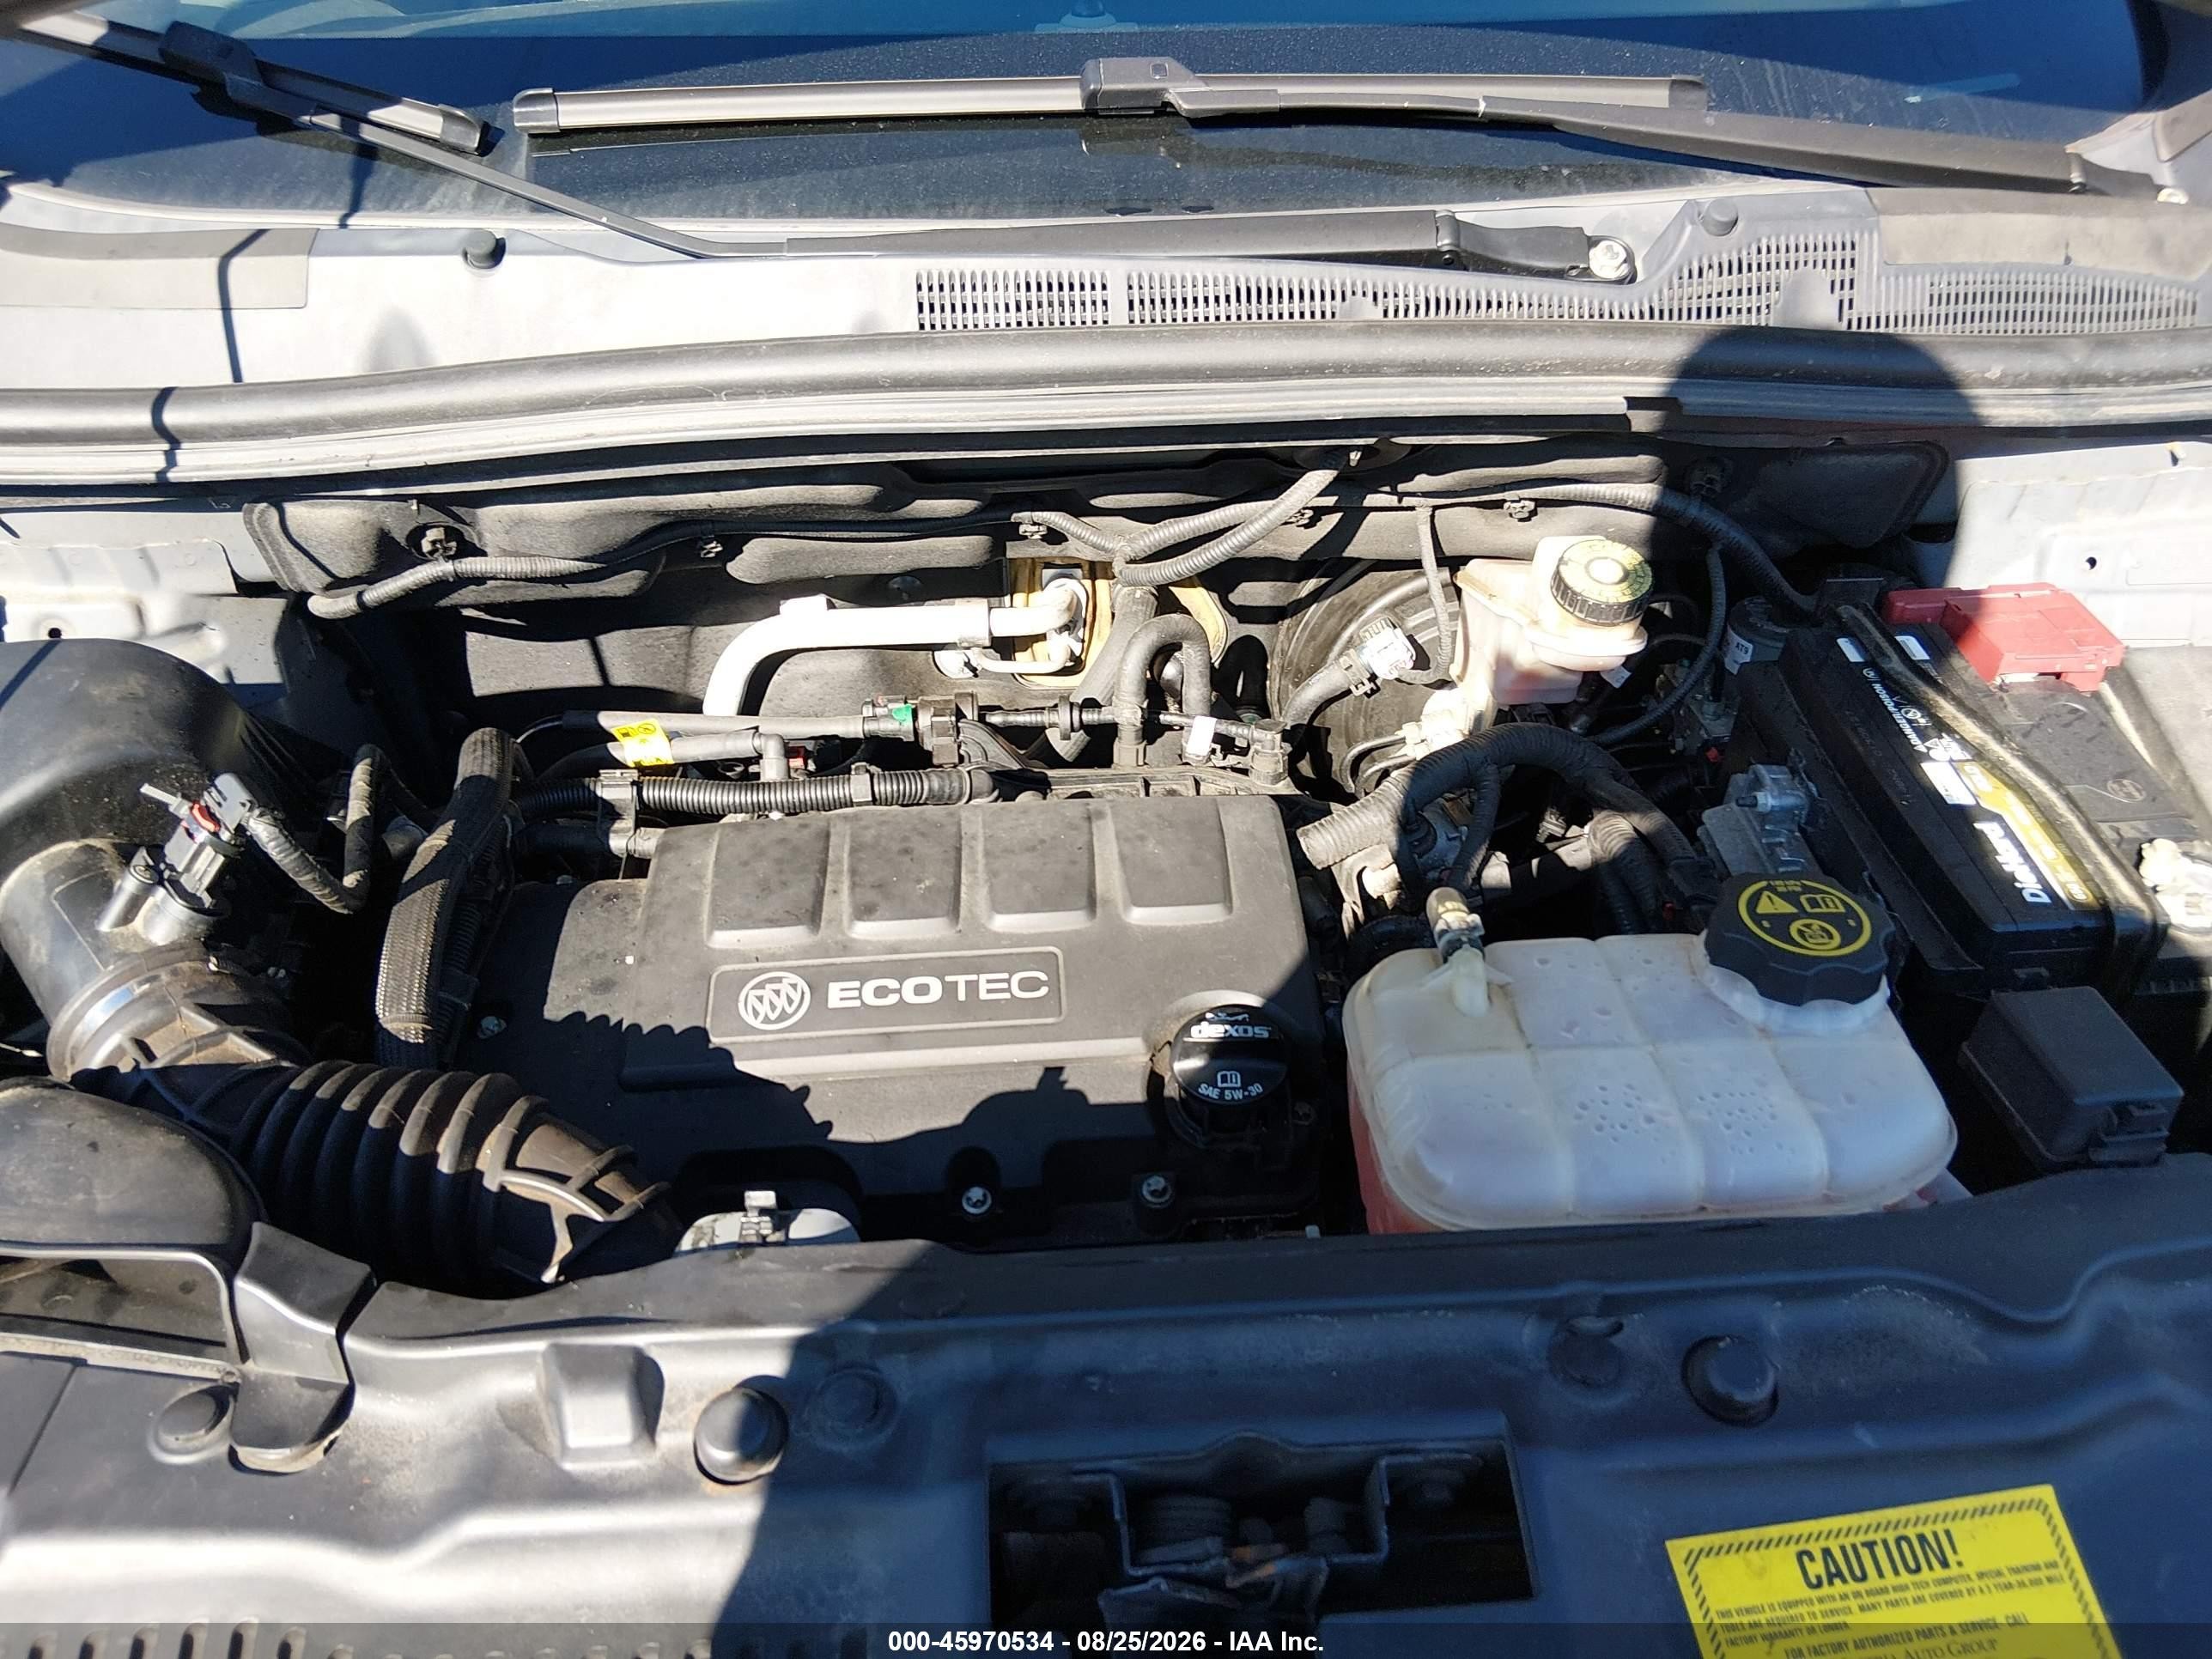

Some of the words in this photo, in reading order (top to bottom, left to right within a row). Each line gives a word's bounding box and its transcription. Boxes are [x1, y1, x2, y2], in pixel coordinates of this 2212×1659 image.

[1871, 683, 1924, 746] DANGER/POISON
[1973, 822, 2052, 902] DieHard
[1190, 1021, 1270, 1038] dexos
[1198, 1083, 1220, 1099] SAE
[1224, 1083, 1263, 1100] 5W-30
[1796, 1528, 1965, 1589] CAUTION!
[1734, 1604, 1765, 1617] VEHICLE
[1777, 1596, 1815, 1610] EQUIPPED
[1814, 1593, 1838, 1605] WITH
[1838, 1591, 1850, 1601] AN
[1911, 1579, 1931, 1590] TECH
[2007, 1563, 2043, 1577] TRAINING
[1765, 1612, 1806, 1626] REQUIRED
[1807, 1610, 1819, 1620] TO
[1857, 1601, 1882, 1613] MANY
[1884, 1597, 1909, 1608] PARTS
[1929, 1589, 1965, 1601] COVERED
[1965, 1588, 1977, 1596] BY
[1725, 1634, 1758, 1647] FACTORY
[1760, 1628, 1803, 1642] WARRANTY
[1784, 1646, 1805, 1659] FOR
[1806, 1640, 1850, 1656] FACTORY
[1851, 1631, 1914, 1649] AUTHORIZED
[1914, 1626, 1947, 1639] PARTS
[1946, 1638, 1998, 1657] GROUP
